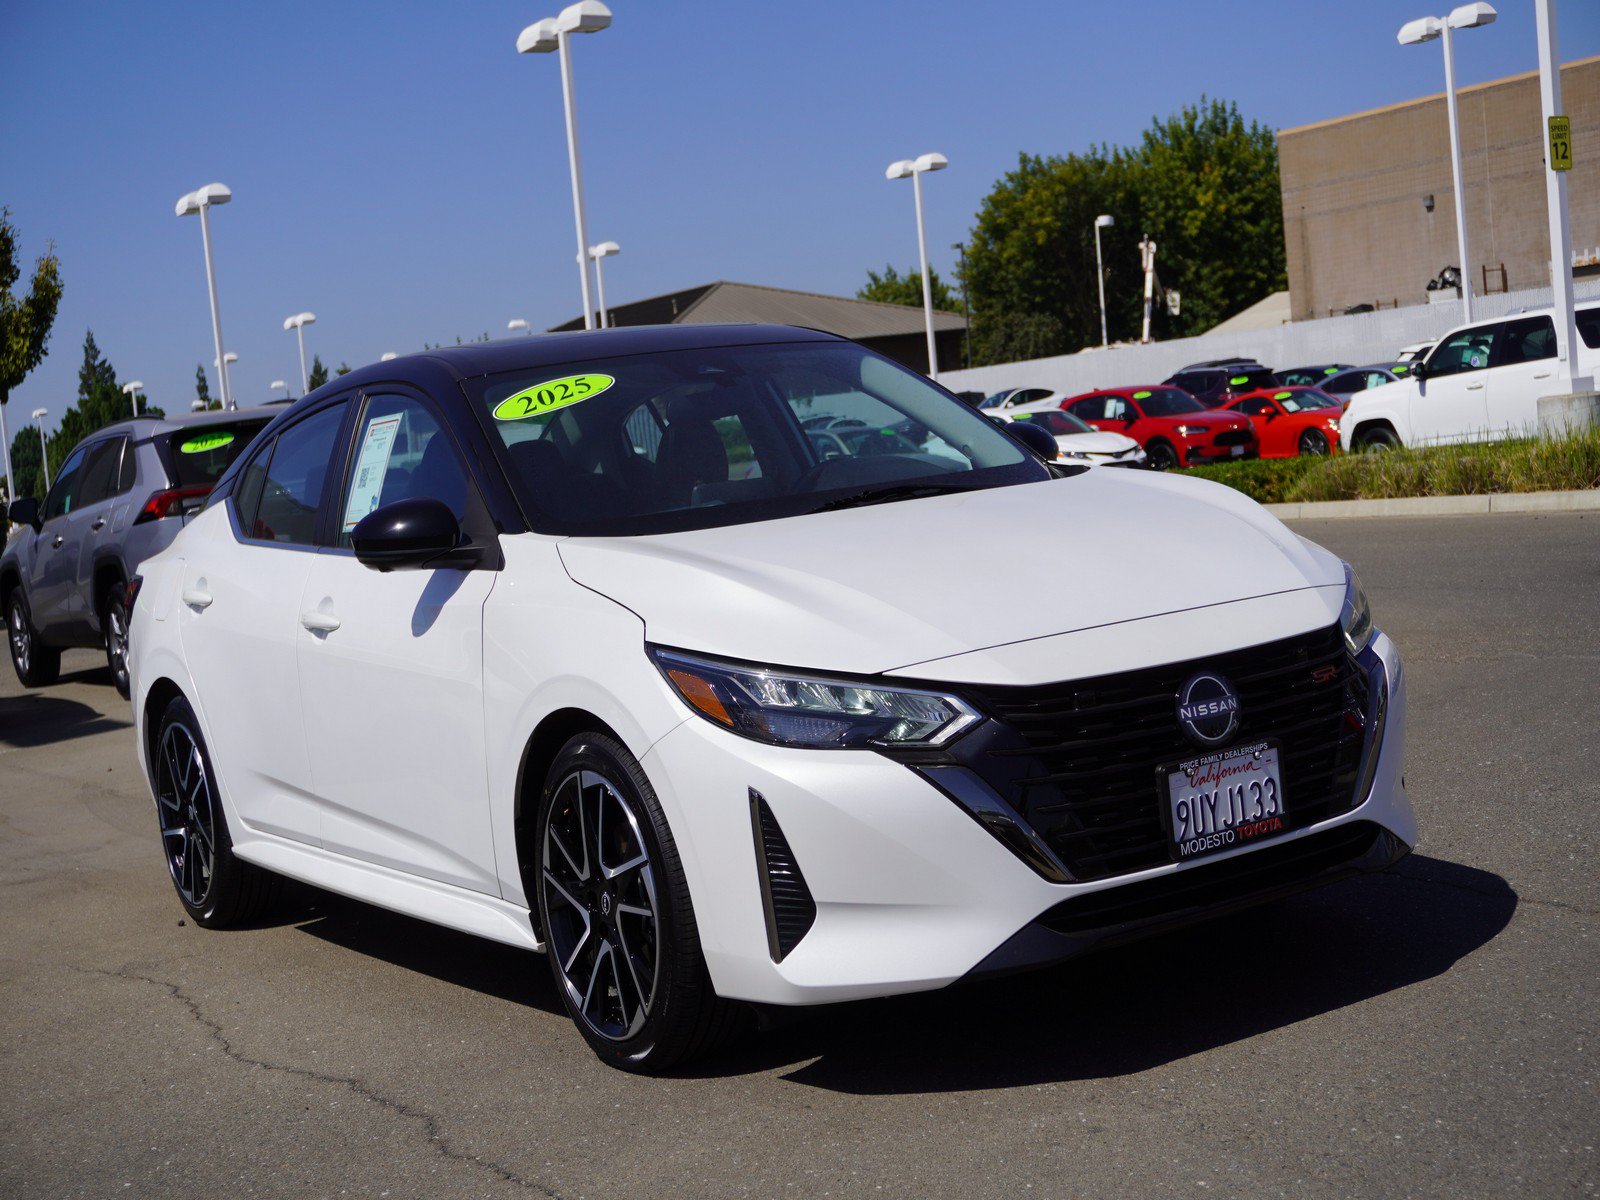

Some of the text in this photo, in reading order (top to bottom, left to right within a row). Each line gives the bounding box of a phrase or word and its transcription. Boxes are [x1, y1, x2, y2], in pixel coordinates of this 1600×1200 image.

[1553, 142, 1568, 160] 12
[517, 377, 591, 415] 2025
[1180, 698, 1237, 719] NISSAN
[1179, 742, 1268, 771] PRICE FAMILY DEALERSHIPS
[1190, 760, 1261, 788] California
[1176, 777, 1278, 841] 9UYJ133
[1180, 817, 1282, 856] MODESTO TOYOTA
